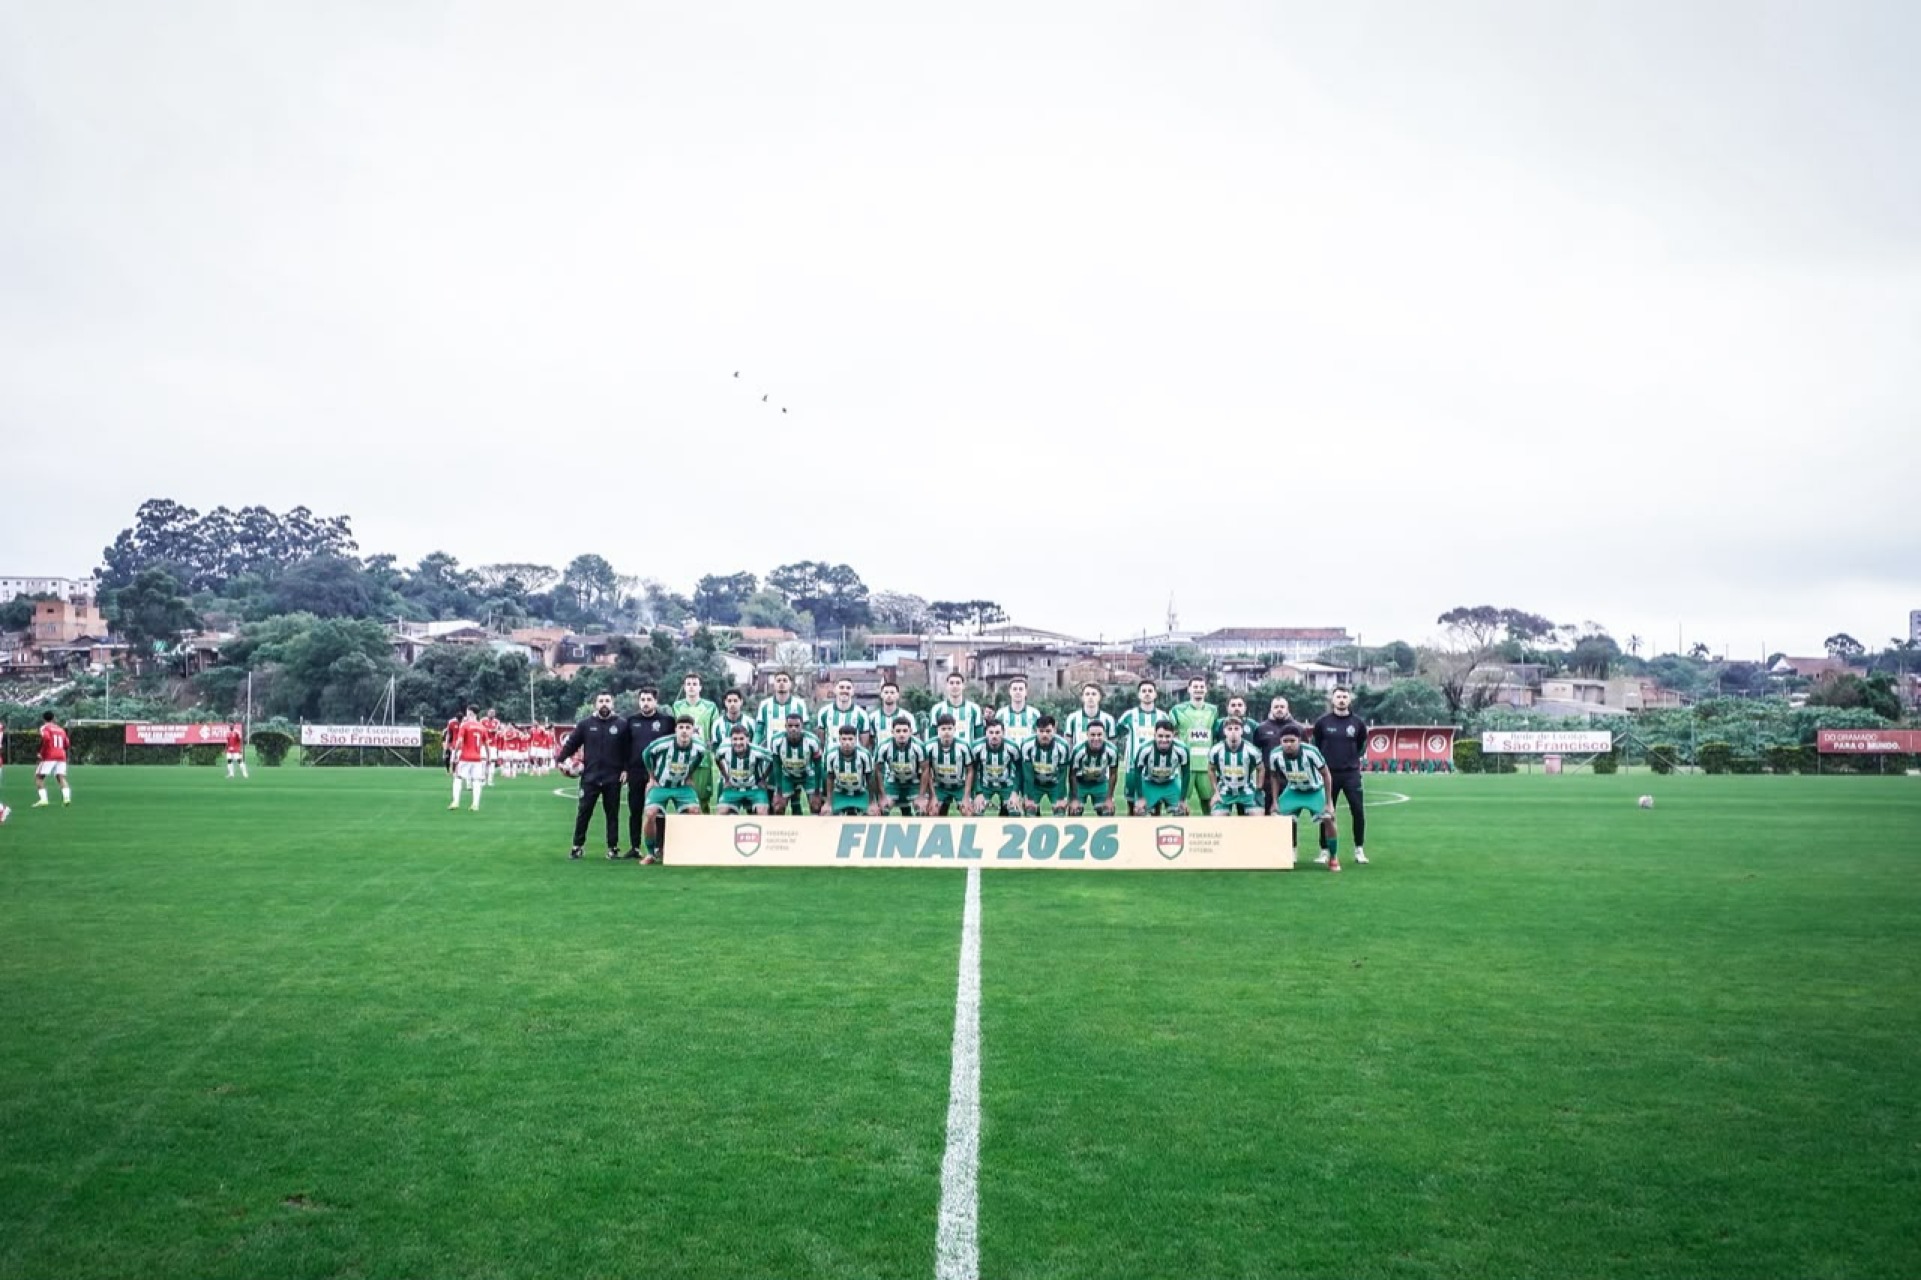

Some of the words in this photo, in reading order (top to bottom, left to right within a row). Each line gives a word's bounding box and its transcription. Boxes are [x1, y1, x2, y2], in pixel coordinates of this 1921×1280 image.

[326, 726, 351, 734] Rede
[352, 726, 364, 734] de
[53, 734, 64, 749] 11
[320, 733, 346, 744] São
[350, 734, 419, 745] Francisco
[1824, 733, 1836, 742] DO
[1837, 733, 1877, 742] GRAMADO
[1535, 740, 1609, 751] Francisco
[1833, 742, 1857, 750] PARA
[1857, 742, 1865, 750] O
[836, 823, 983, 859] FINAL
[997, 823, 1119, 861] 2026
